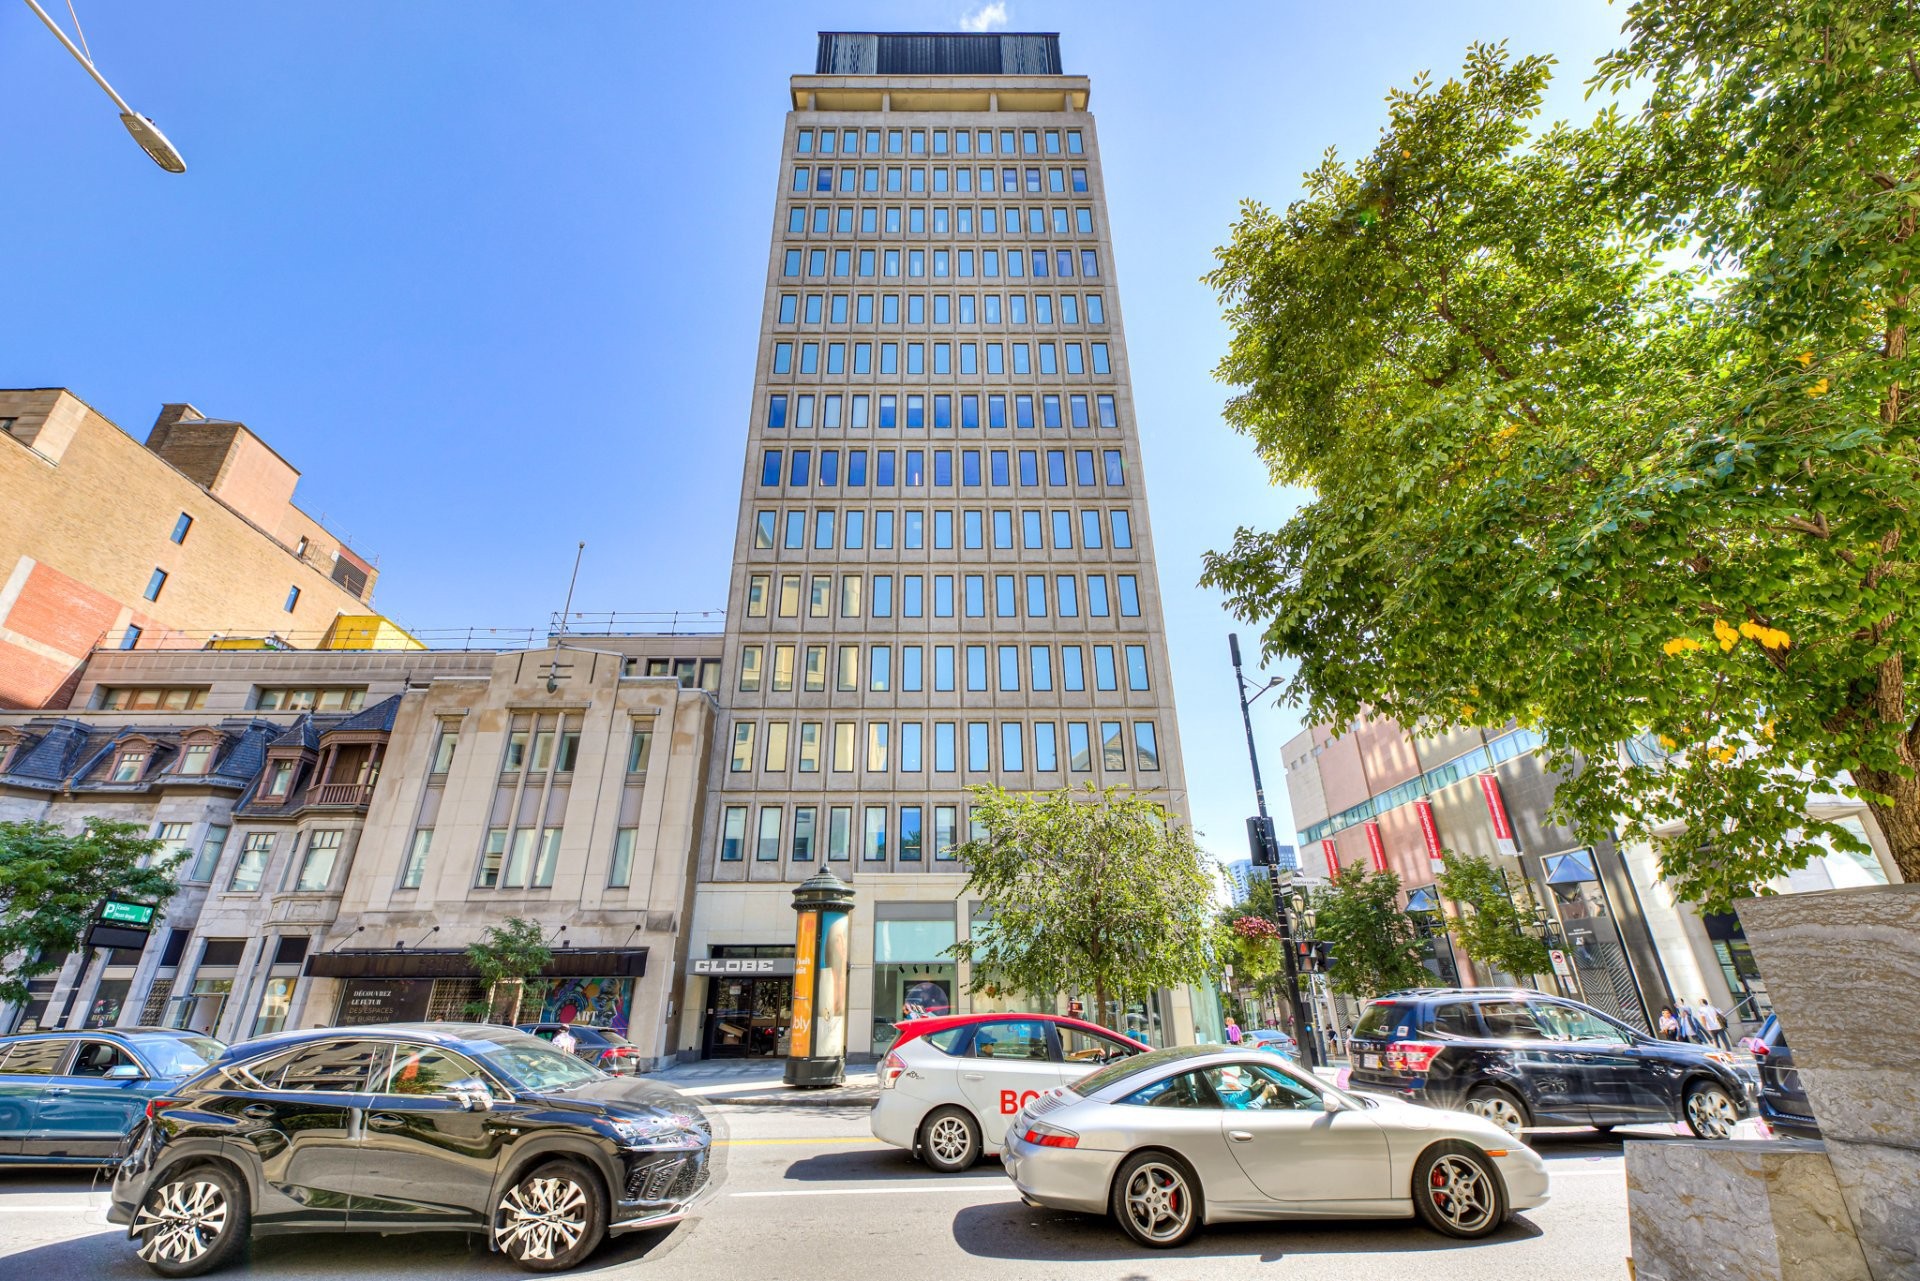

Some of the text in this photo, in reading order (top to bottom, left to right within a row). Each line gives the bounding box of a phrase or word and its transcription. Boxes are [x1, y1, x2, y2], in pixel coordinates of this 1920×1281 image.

[103, 903, 116, 918] P
[694, 960, 774, 972] GLOBE
[353, 989, 392, 997] DÉCOUVREZ
[575, 1010, 599, 1022] ART
[792, 1016, 810, 1033] bly
